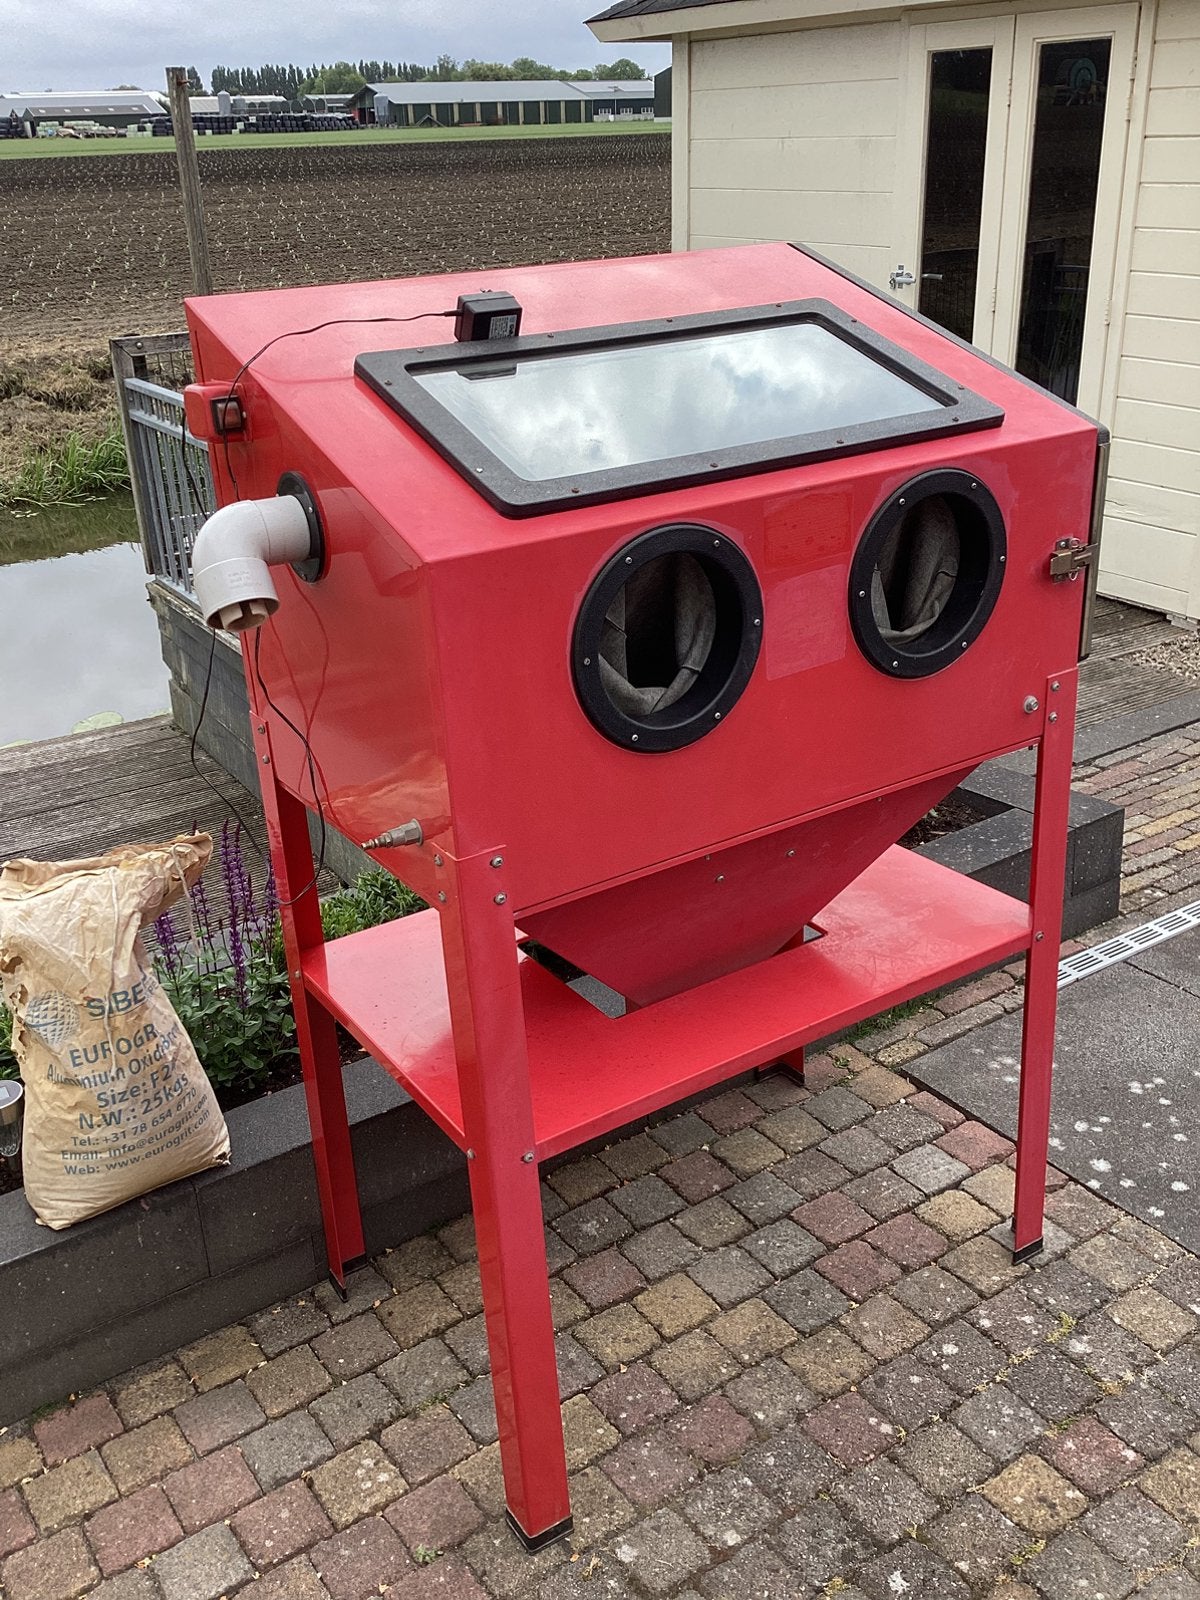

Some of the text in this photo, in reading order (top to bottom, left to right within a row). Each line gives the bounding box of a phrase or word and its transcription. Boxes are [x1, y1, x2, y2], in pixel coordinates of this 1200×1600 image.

[86, 982, 146, 1017] SIBE
[69, 1023, 159, 1068] EUROGR
[70, 1087, 197, 1147] Tel.: +31 78 654 6770
[79, 1073, 189, 1130] N.W.: 25kgs
[96, 1081, 147, 1108] Size:
[61, 1094, 208, 1160] Email: info@eurogrit.com
[64, 1109, 210, 1175] Web: www.eurogrit.com
